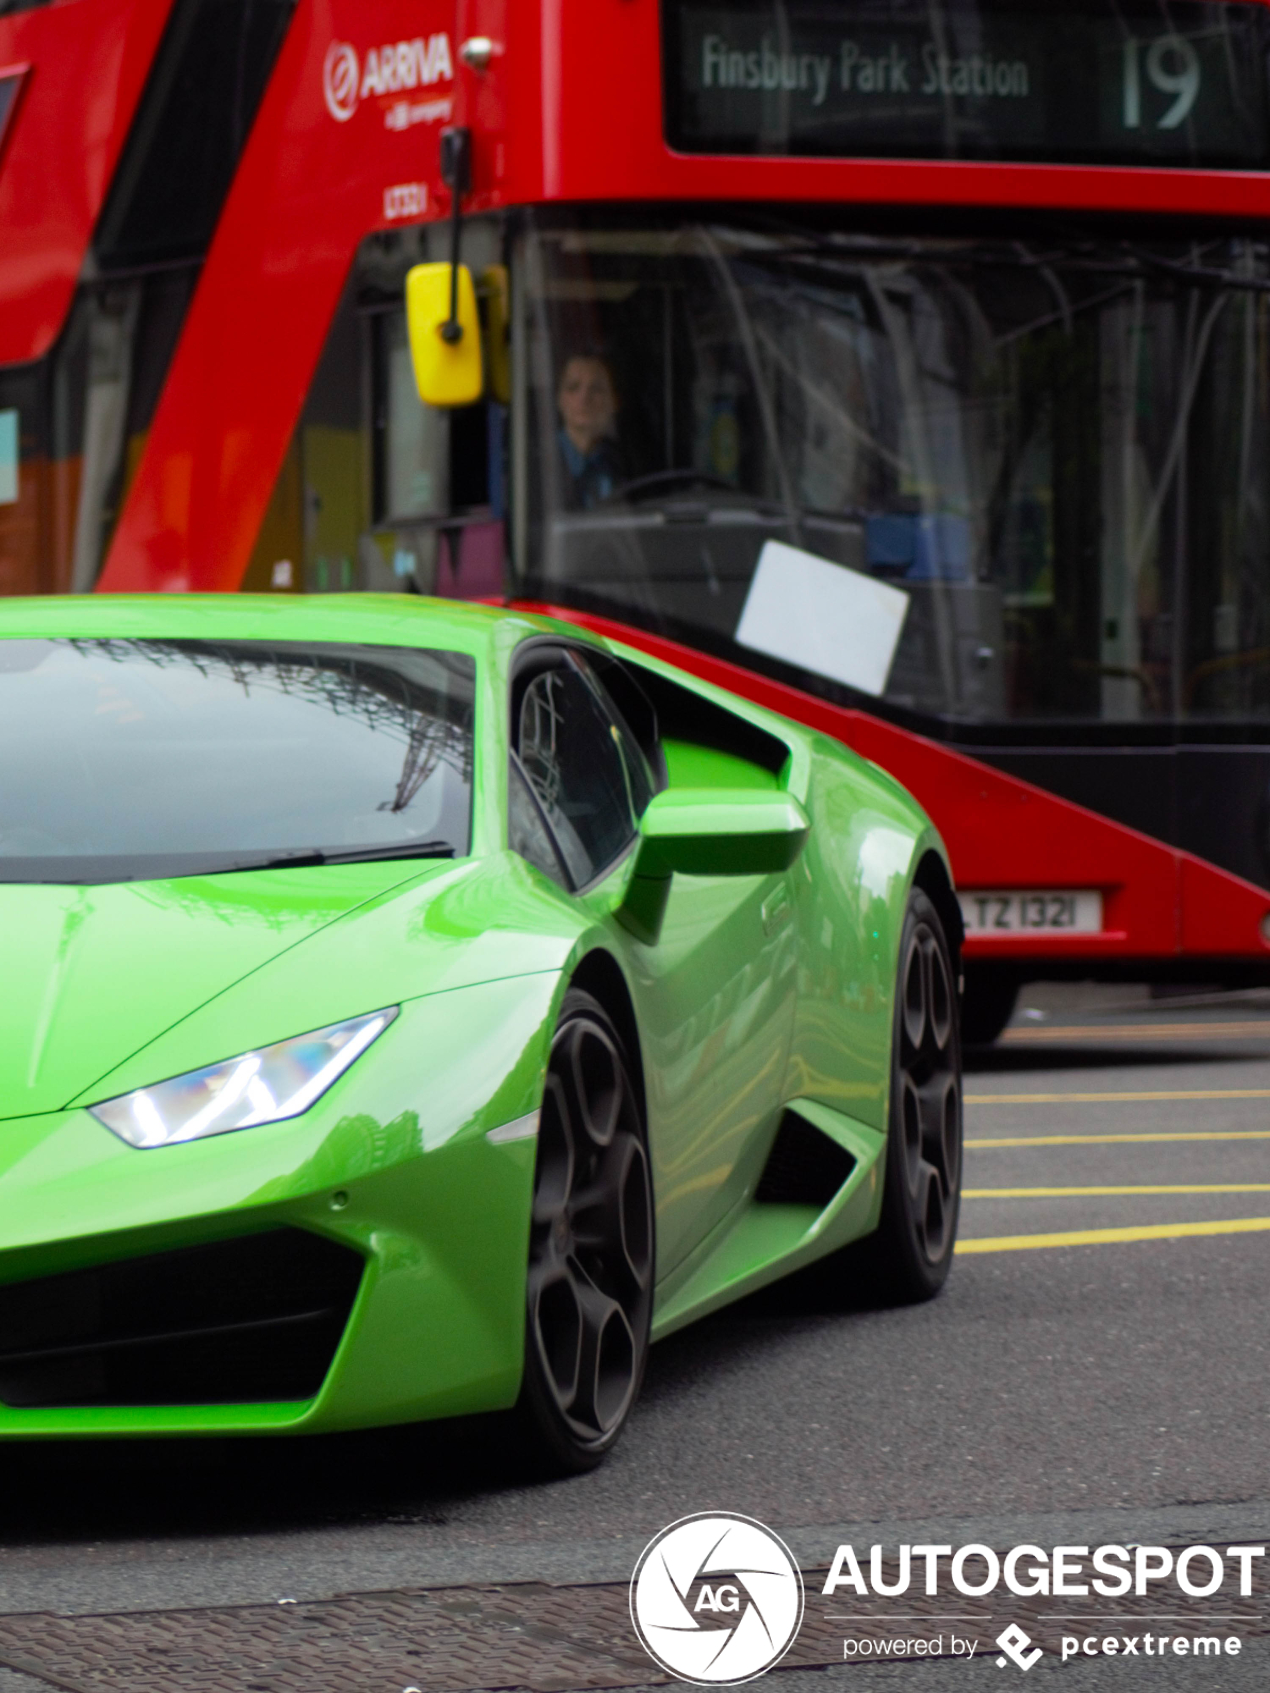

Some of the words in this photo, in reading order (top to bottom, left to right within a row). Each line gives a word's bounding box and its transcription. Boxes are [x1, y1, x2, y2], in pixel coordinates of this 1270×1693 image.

[360, 34, 453, 98] ARRIVA
[701, 34, 830, 105] Finsbury
[840, 40, 910, 93] Park
[921, 42, 1028, 96] Station
[1123, 33, 1200, 129] 19
